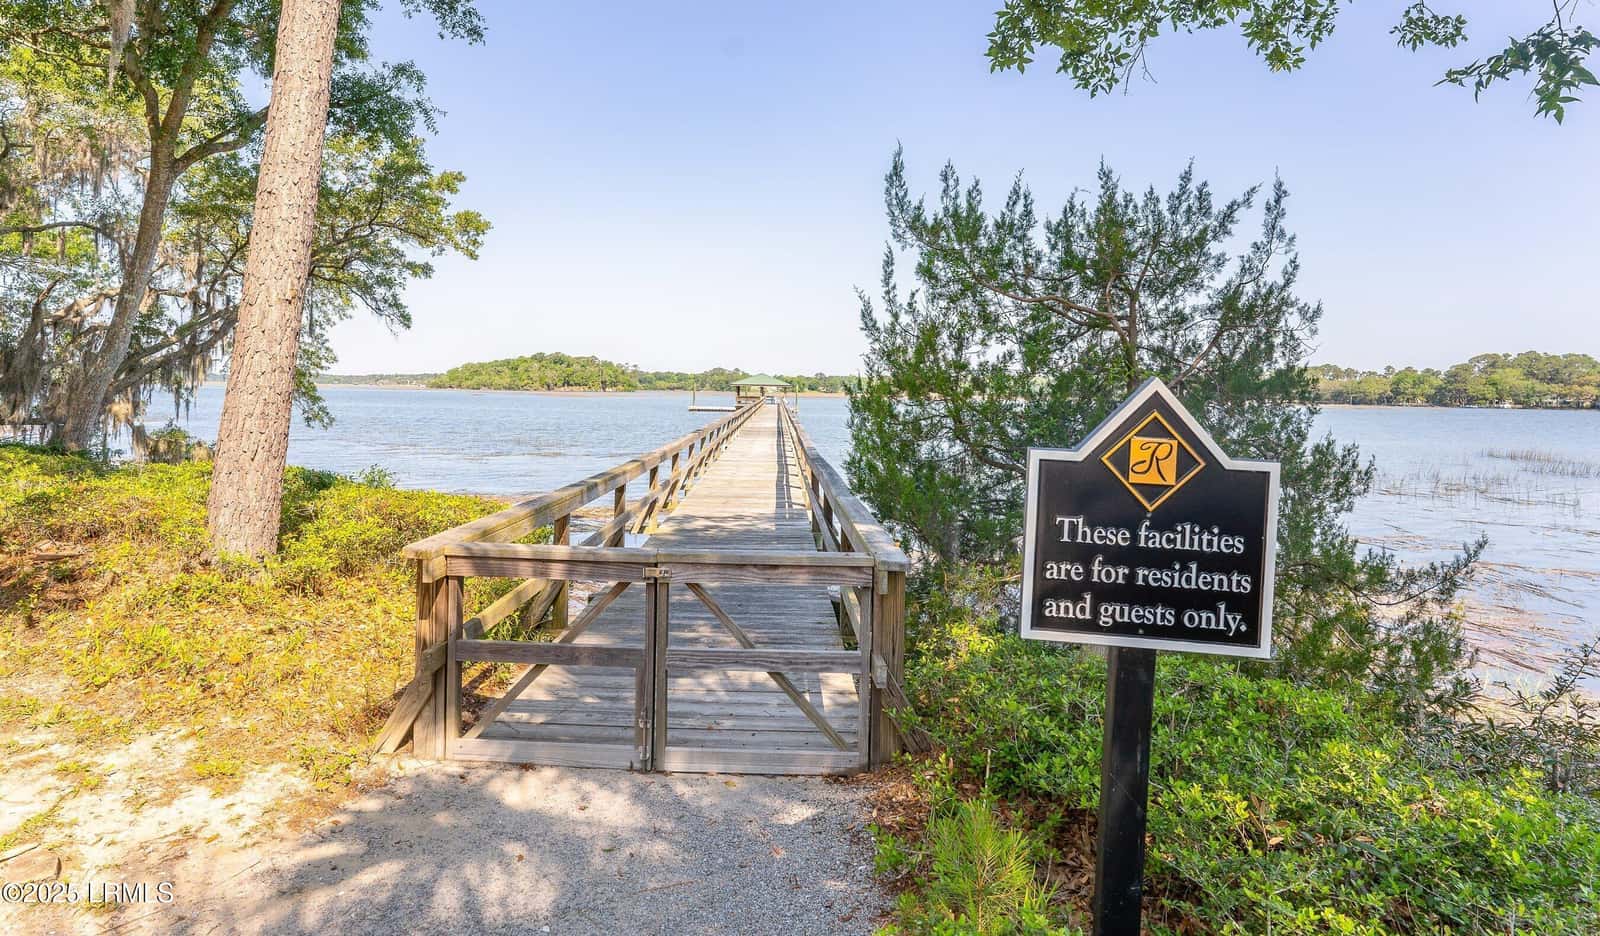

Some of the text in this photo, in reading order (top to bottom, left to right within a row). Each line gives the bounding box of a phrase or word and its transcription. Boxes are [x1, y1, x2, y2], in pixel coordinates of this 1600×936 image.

[1055, 515, 1245, 554] These facilities
[1044, 556, 1251, 593] are for residents
[1044, 592, 1248, 636] and guests only.
